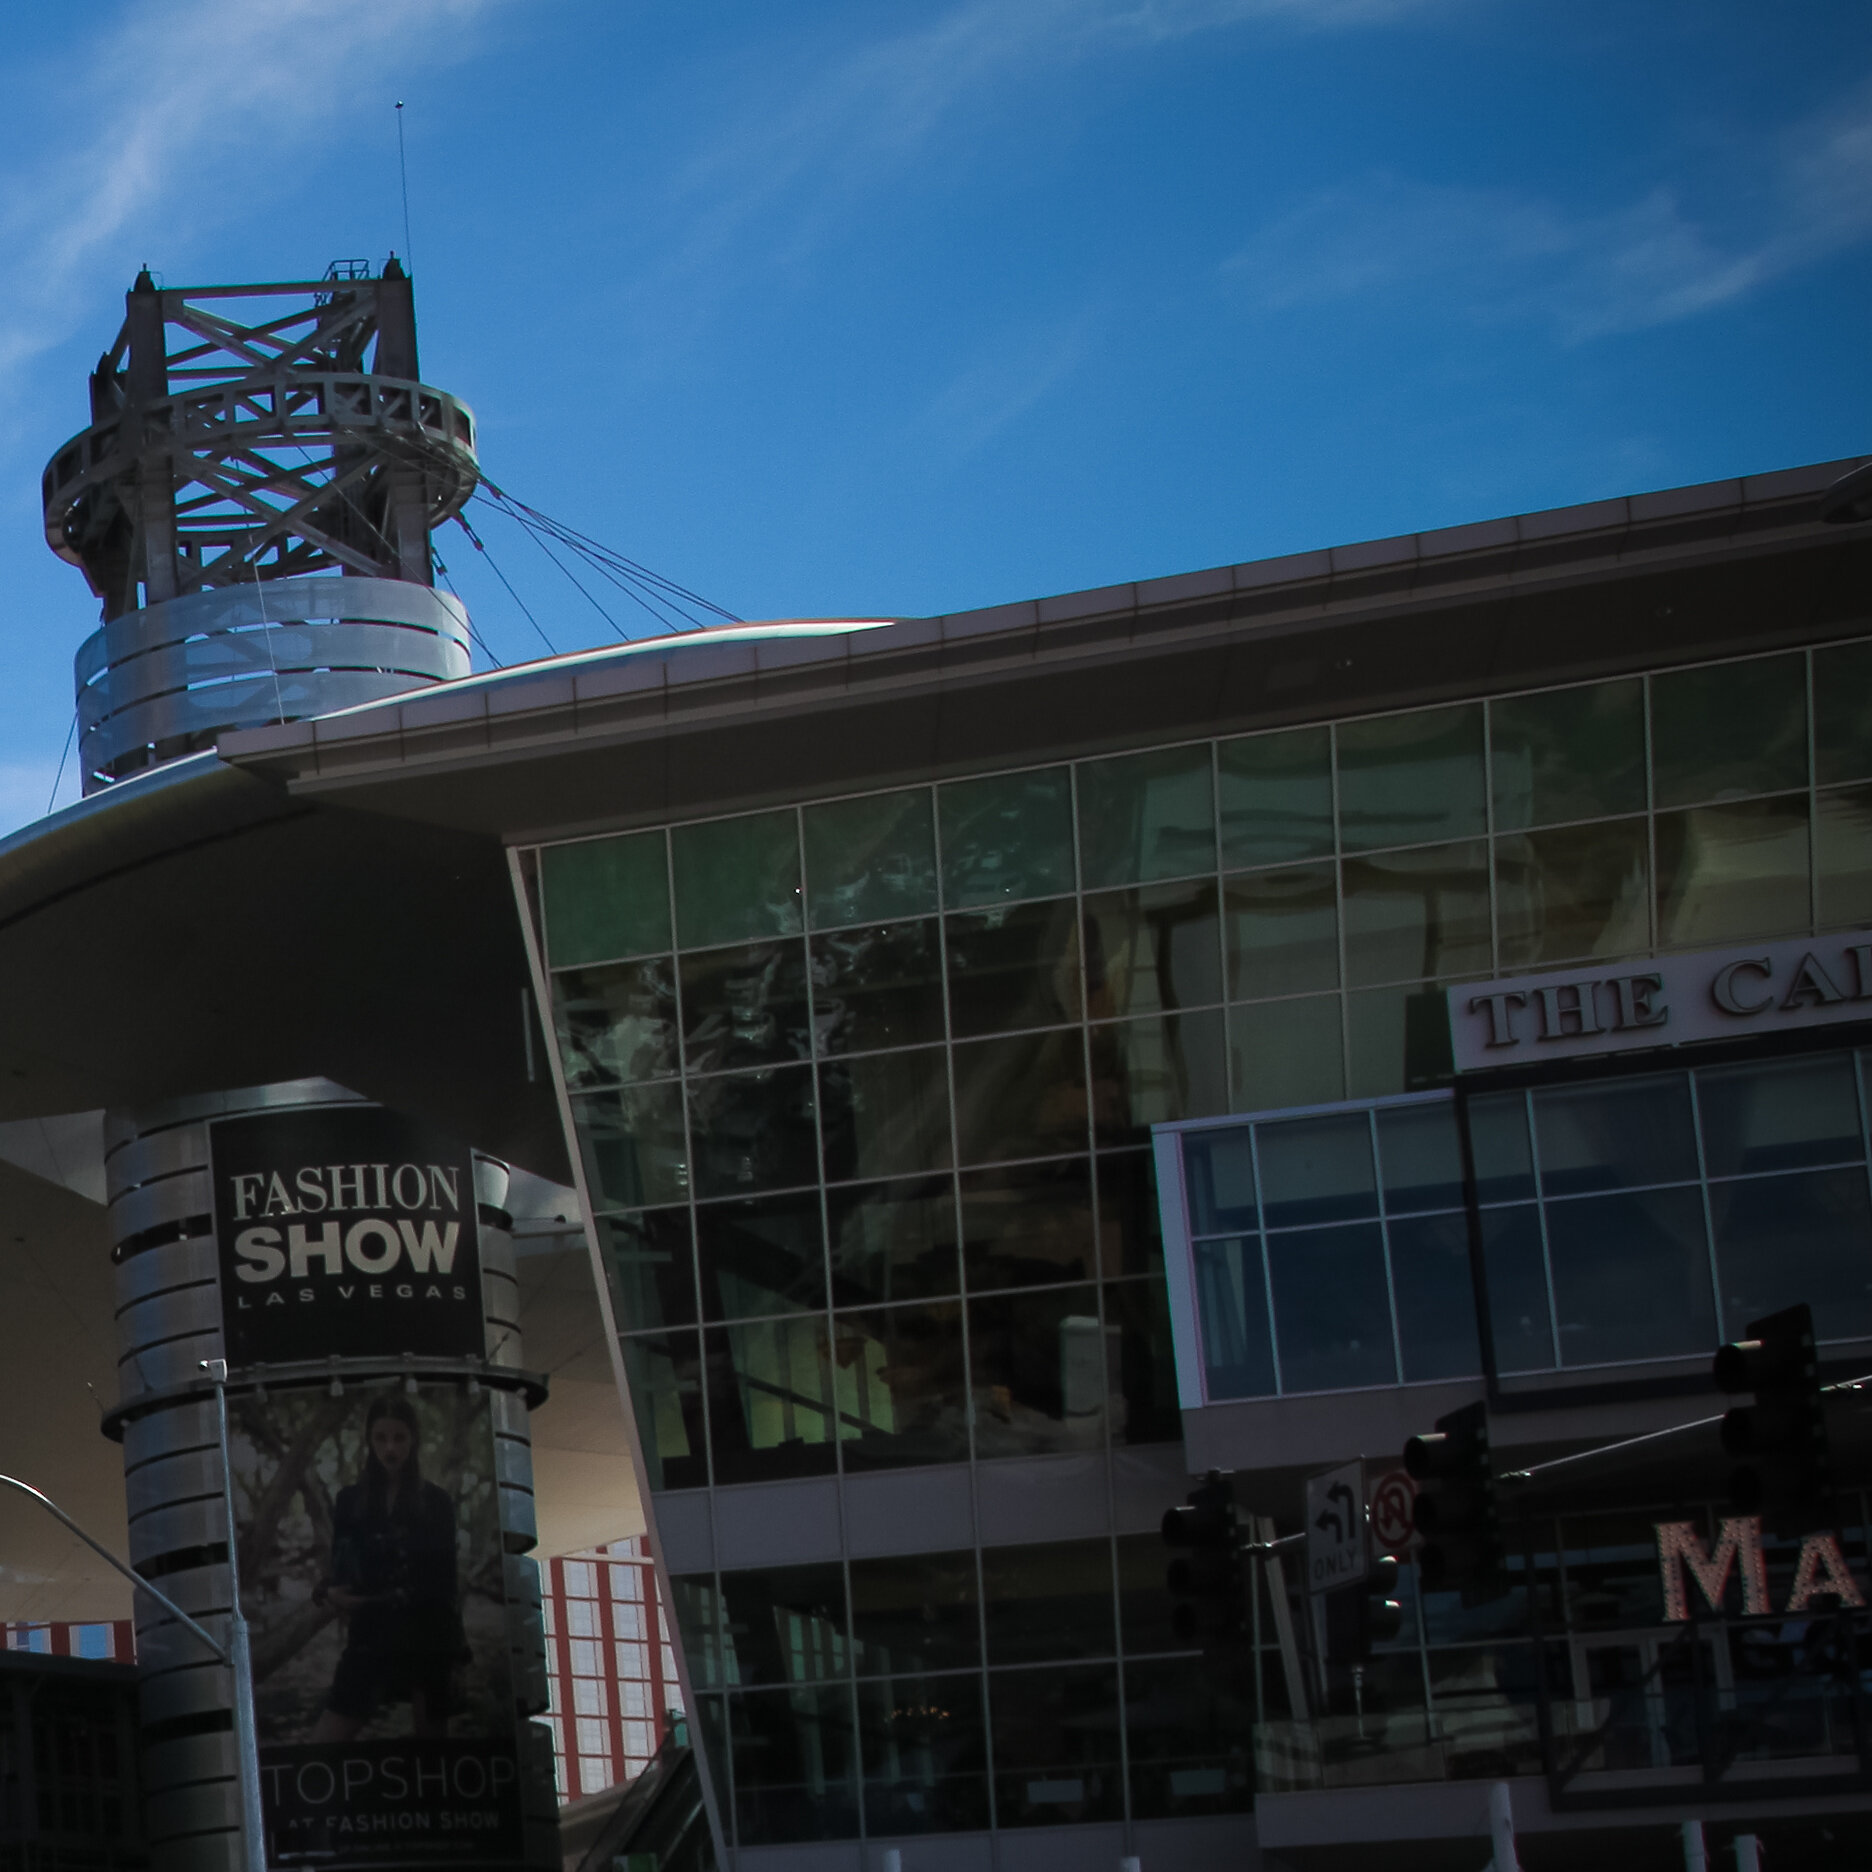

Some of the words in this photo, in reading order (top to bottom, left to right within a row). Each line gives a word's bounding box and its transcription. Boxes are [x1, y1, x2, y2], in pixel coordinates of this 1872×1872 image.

[1469, 973, 1670, 1048] THE
[229, 1162, 461, 1221] FASHION
[233, 1217, 461, 1283] SHOW
[237, 1287, 315, 1310] LAS
[337, 1283, 468, 1301] VEGAS
[1313, 1548, 1357, 1580] ONLY
[261, 1755, 515, 1807] TOPSHOP
[326, 1811, 431, 1832] FASHION
[440, 1809, 501, 1830] SHOW
